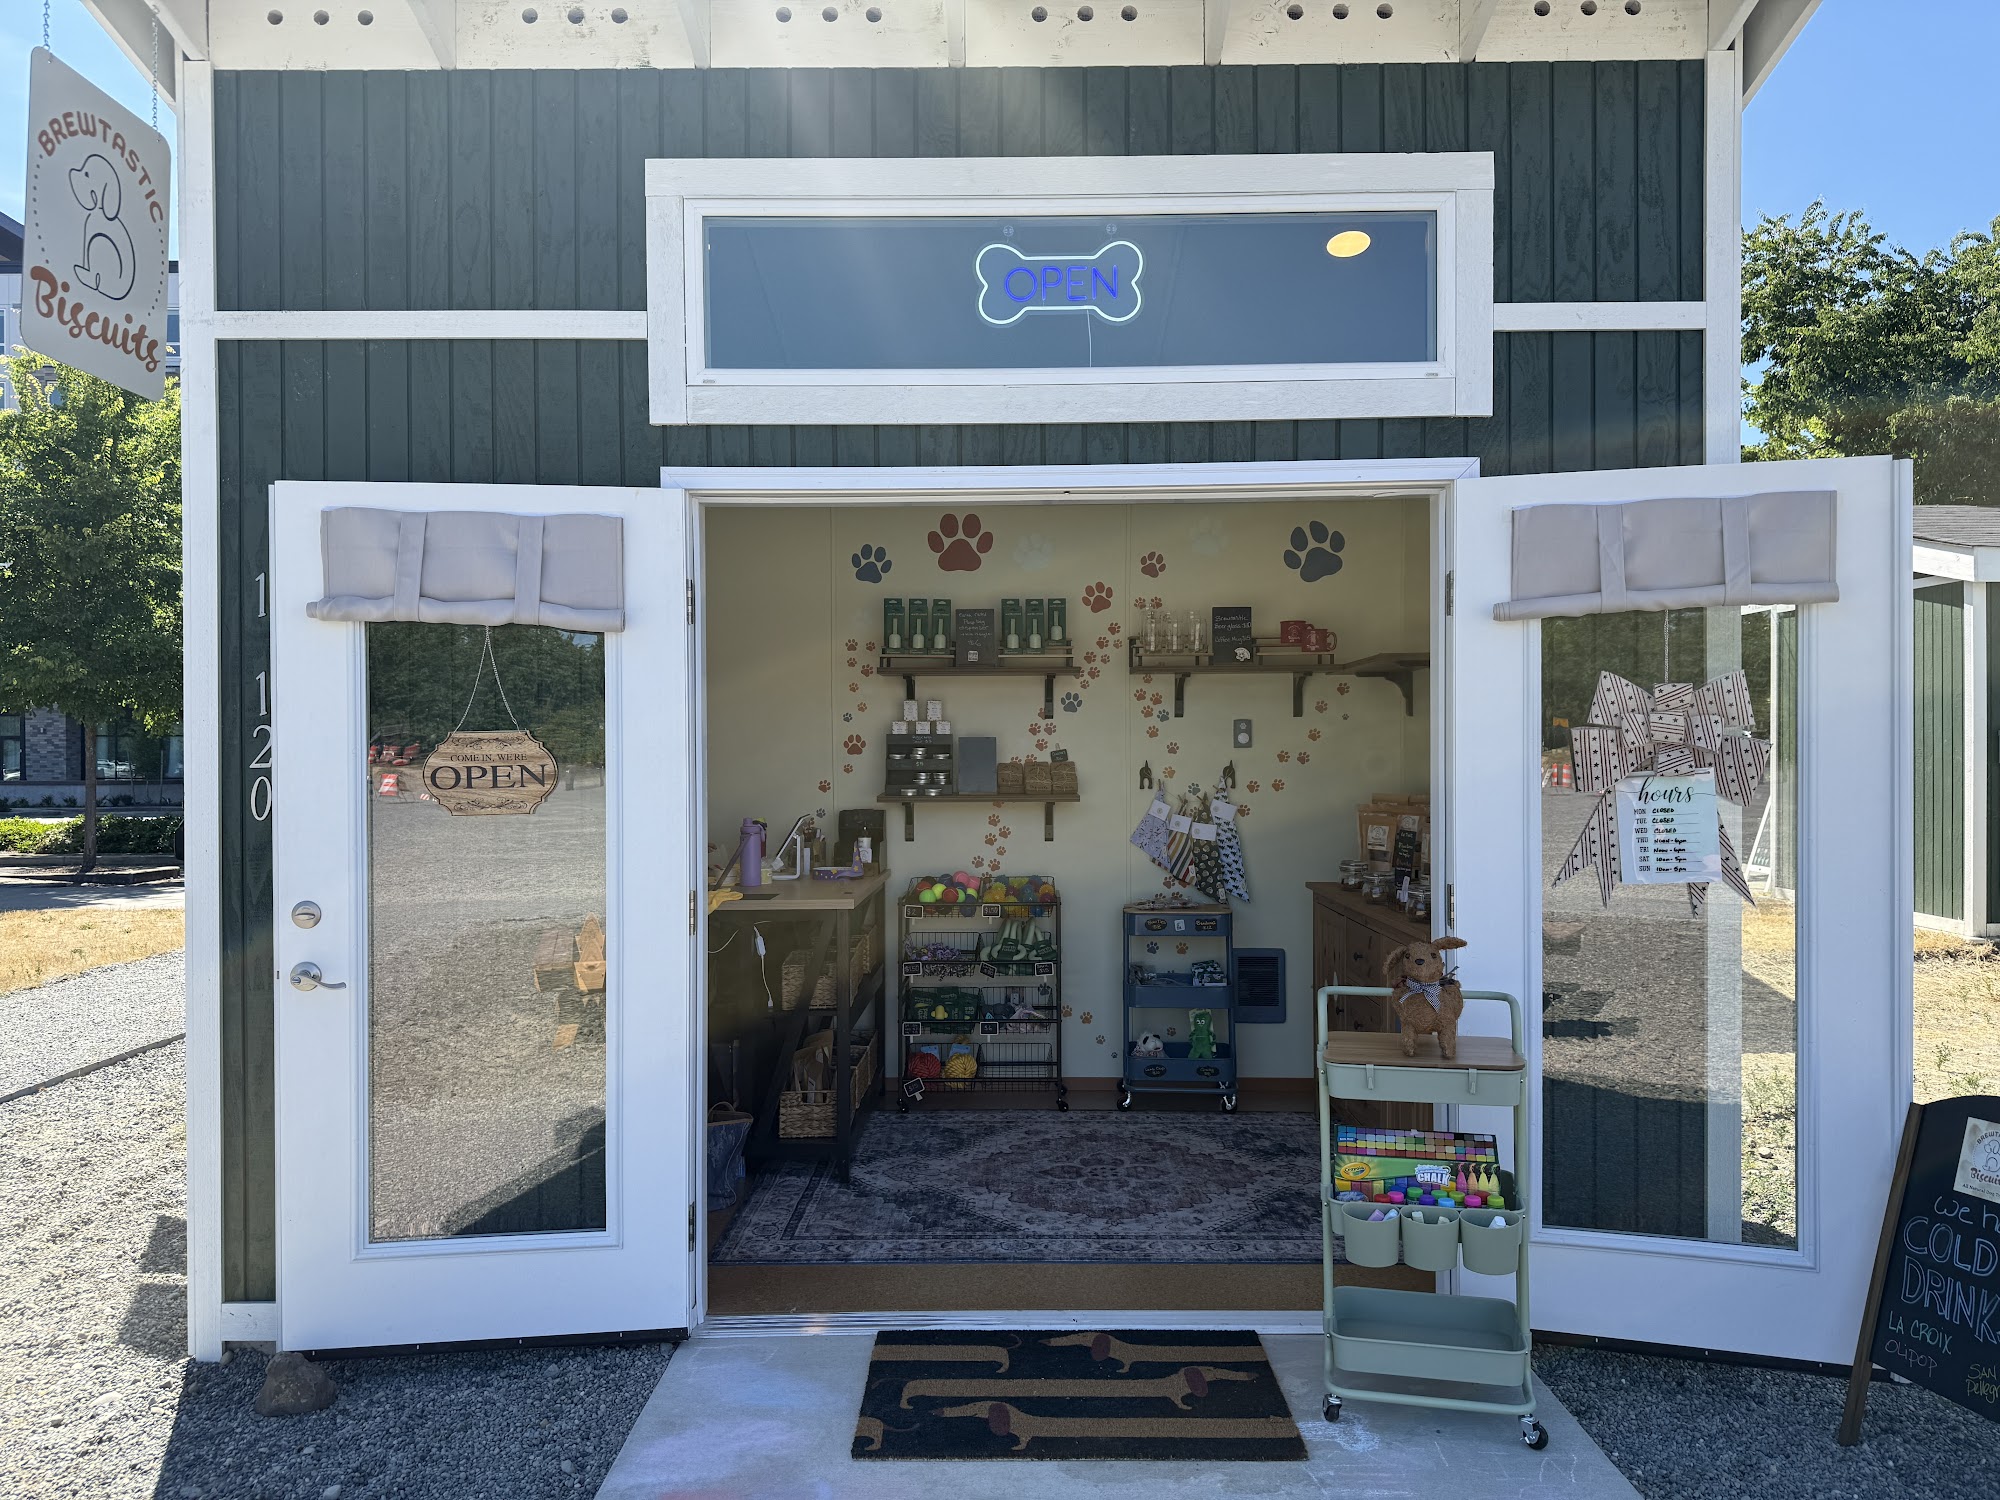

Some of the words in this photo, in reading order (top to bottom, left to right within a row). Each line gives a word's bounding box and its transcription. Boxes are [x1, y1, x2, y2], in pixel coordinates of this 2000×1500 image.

[38, 110, 164, 224] BREWTASTIC
[1004, 264, 1118, 302] OPEN
[30, 265, 161, 373] Biscuits
[450, 754, 479, 762] COME
[482, 754, 494, 762] IN,
[430, 764, 549, 790] OPEN
[1638, 776, 1694, 804] hours
[1417, 1172, 1449, 1186] CHALK
[1934, 1196, 1974, 1225] We
[1904, 1215, 1999, 1277] COLD
[1900, 1254, 2000, 1345] DRINK
[1888, 1310, 1904, 1335] LA
[1967, 1363, 1997, 1381] SAN
